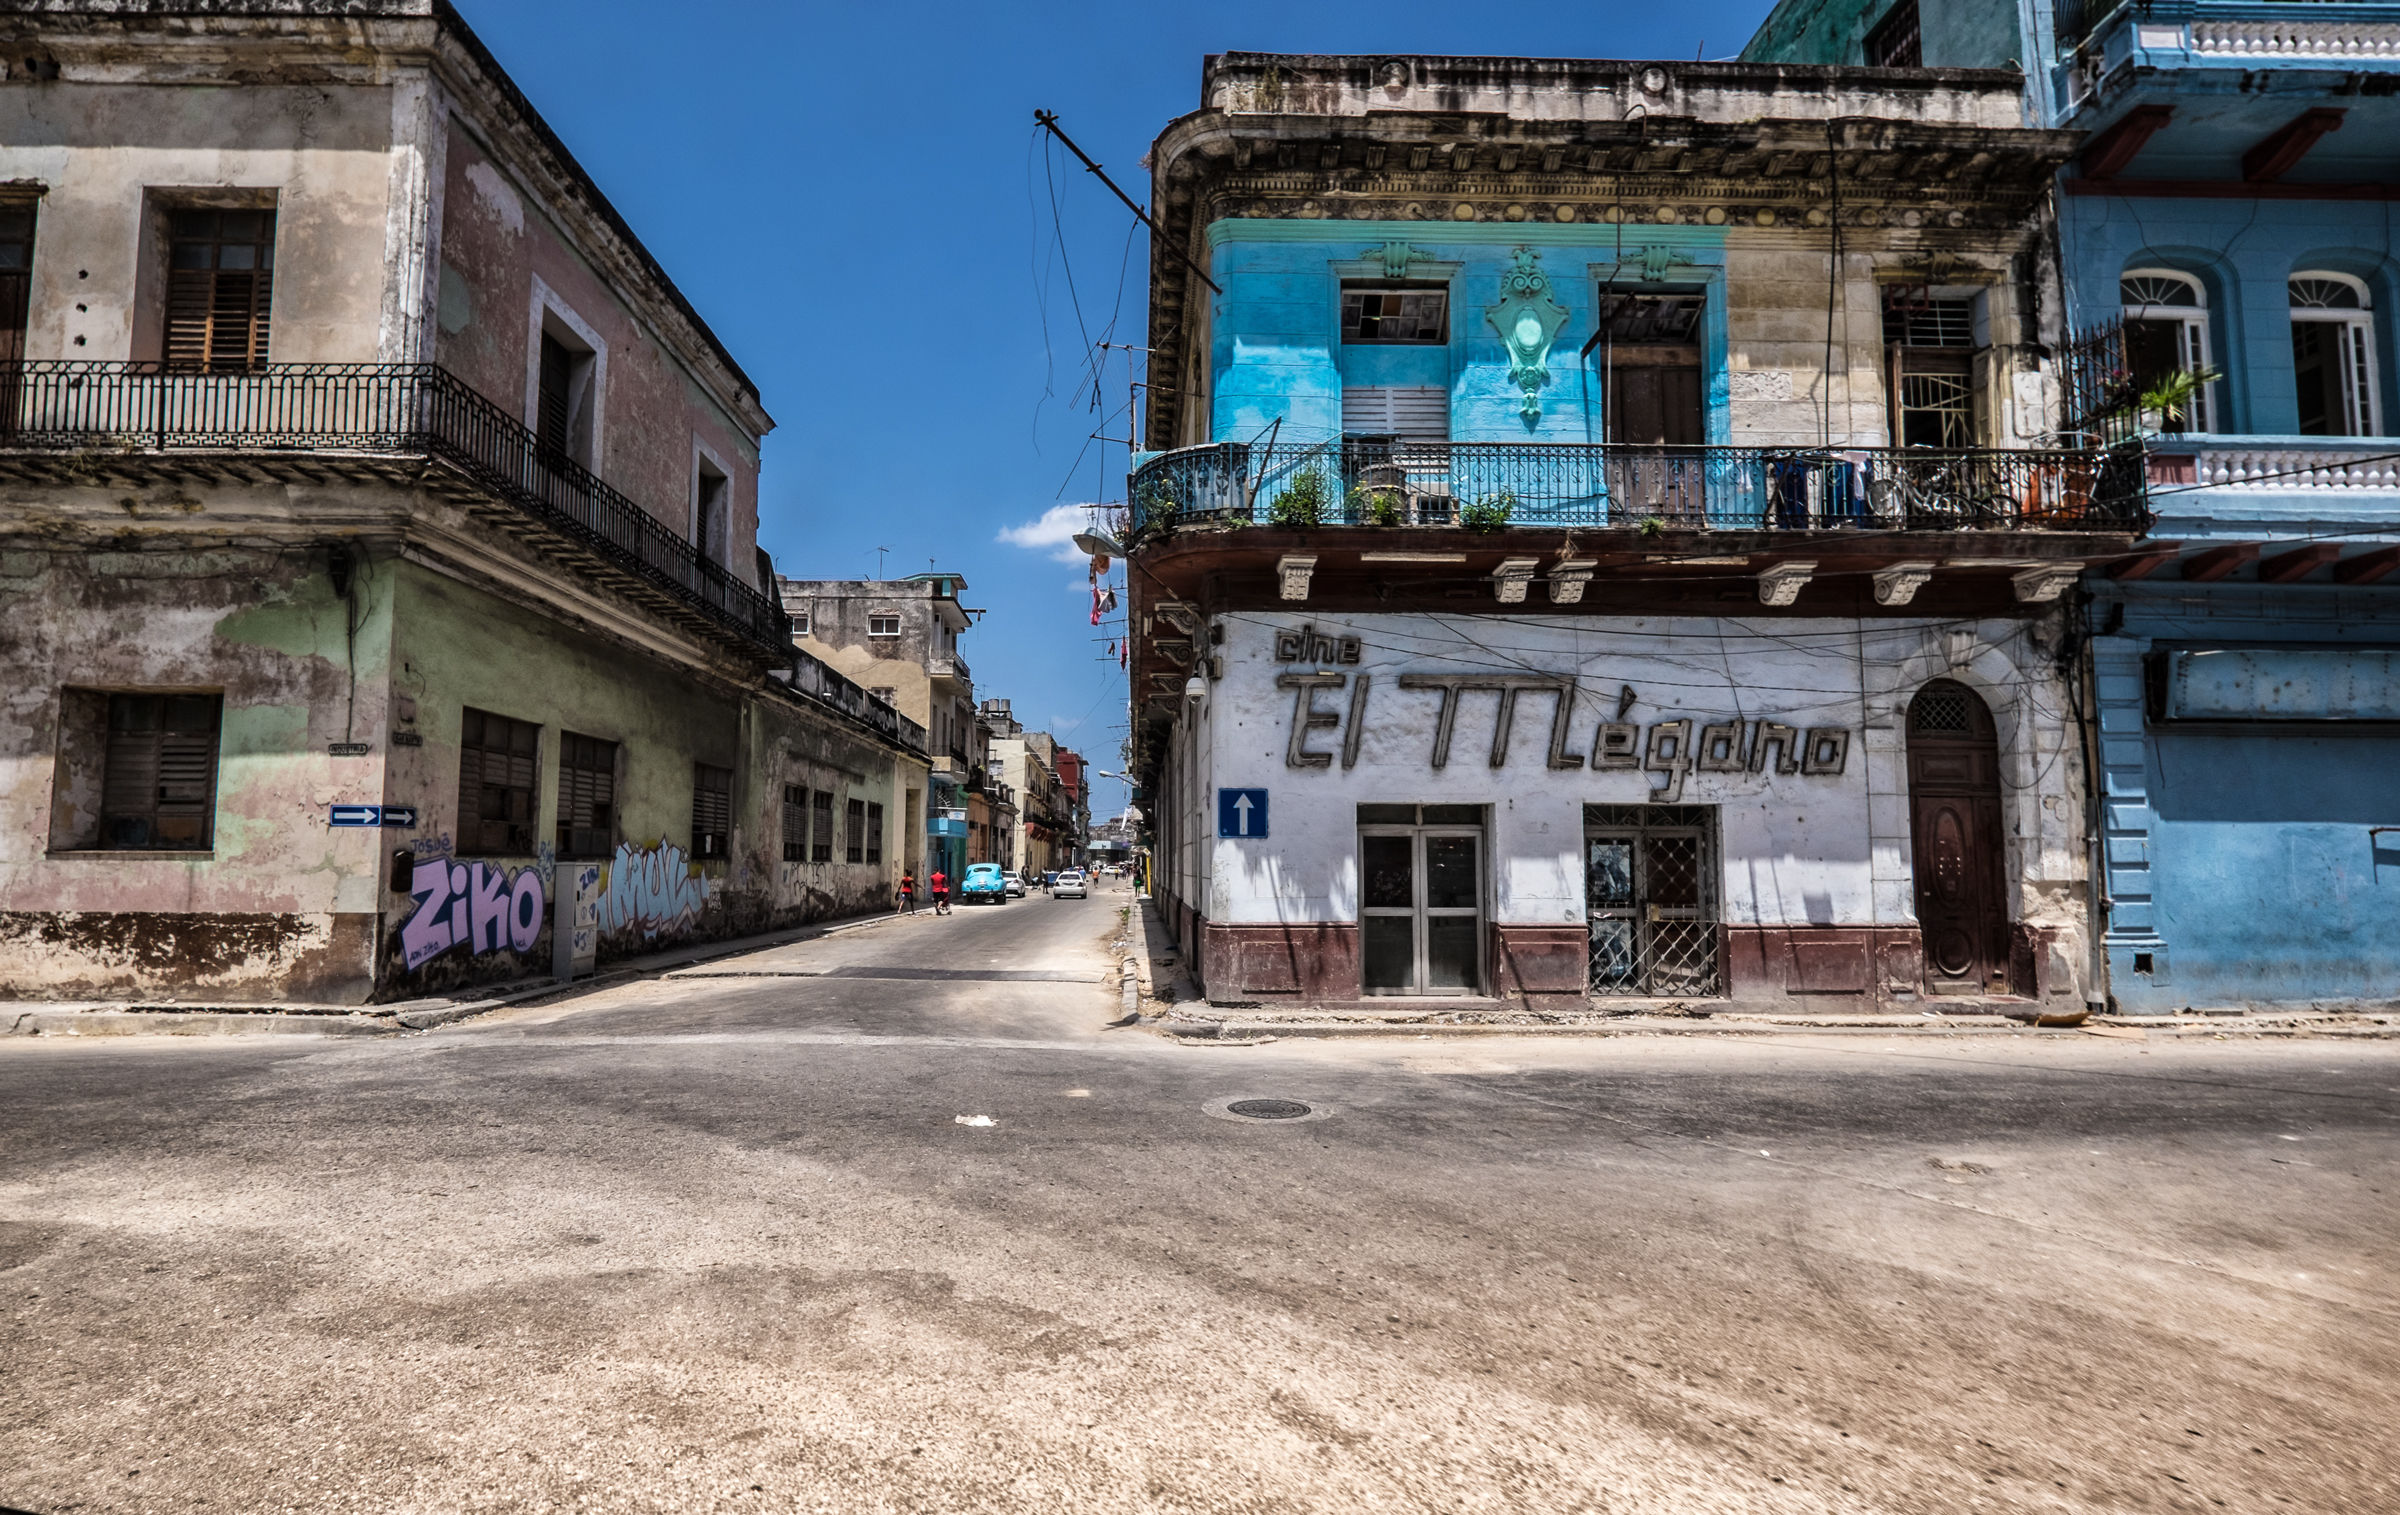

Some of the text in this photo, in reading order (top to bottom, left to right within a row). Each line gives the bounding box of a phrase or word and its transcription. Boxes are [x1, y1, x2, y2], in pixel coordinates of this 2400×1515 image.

[1275, 624, 1362, 665] cine
[1277, 674, 1850, 803] El Mégano
